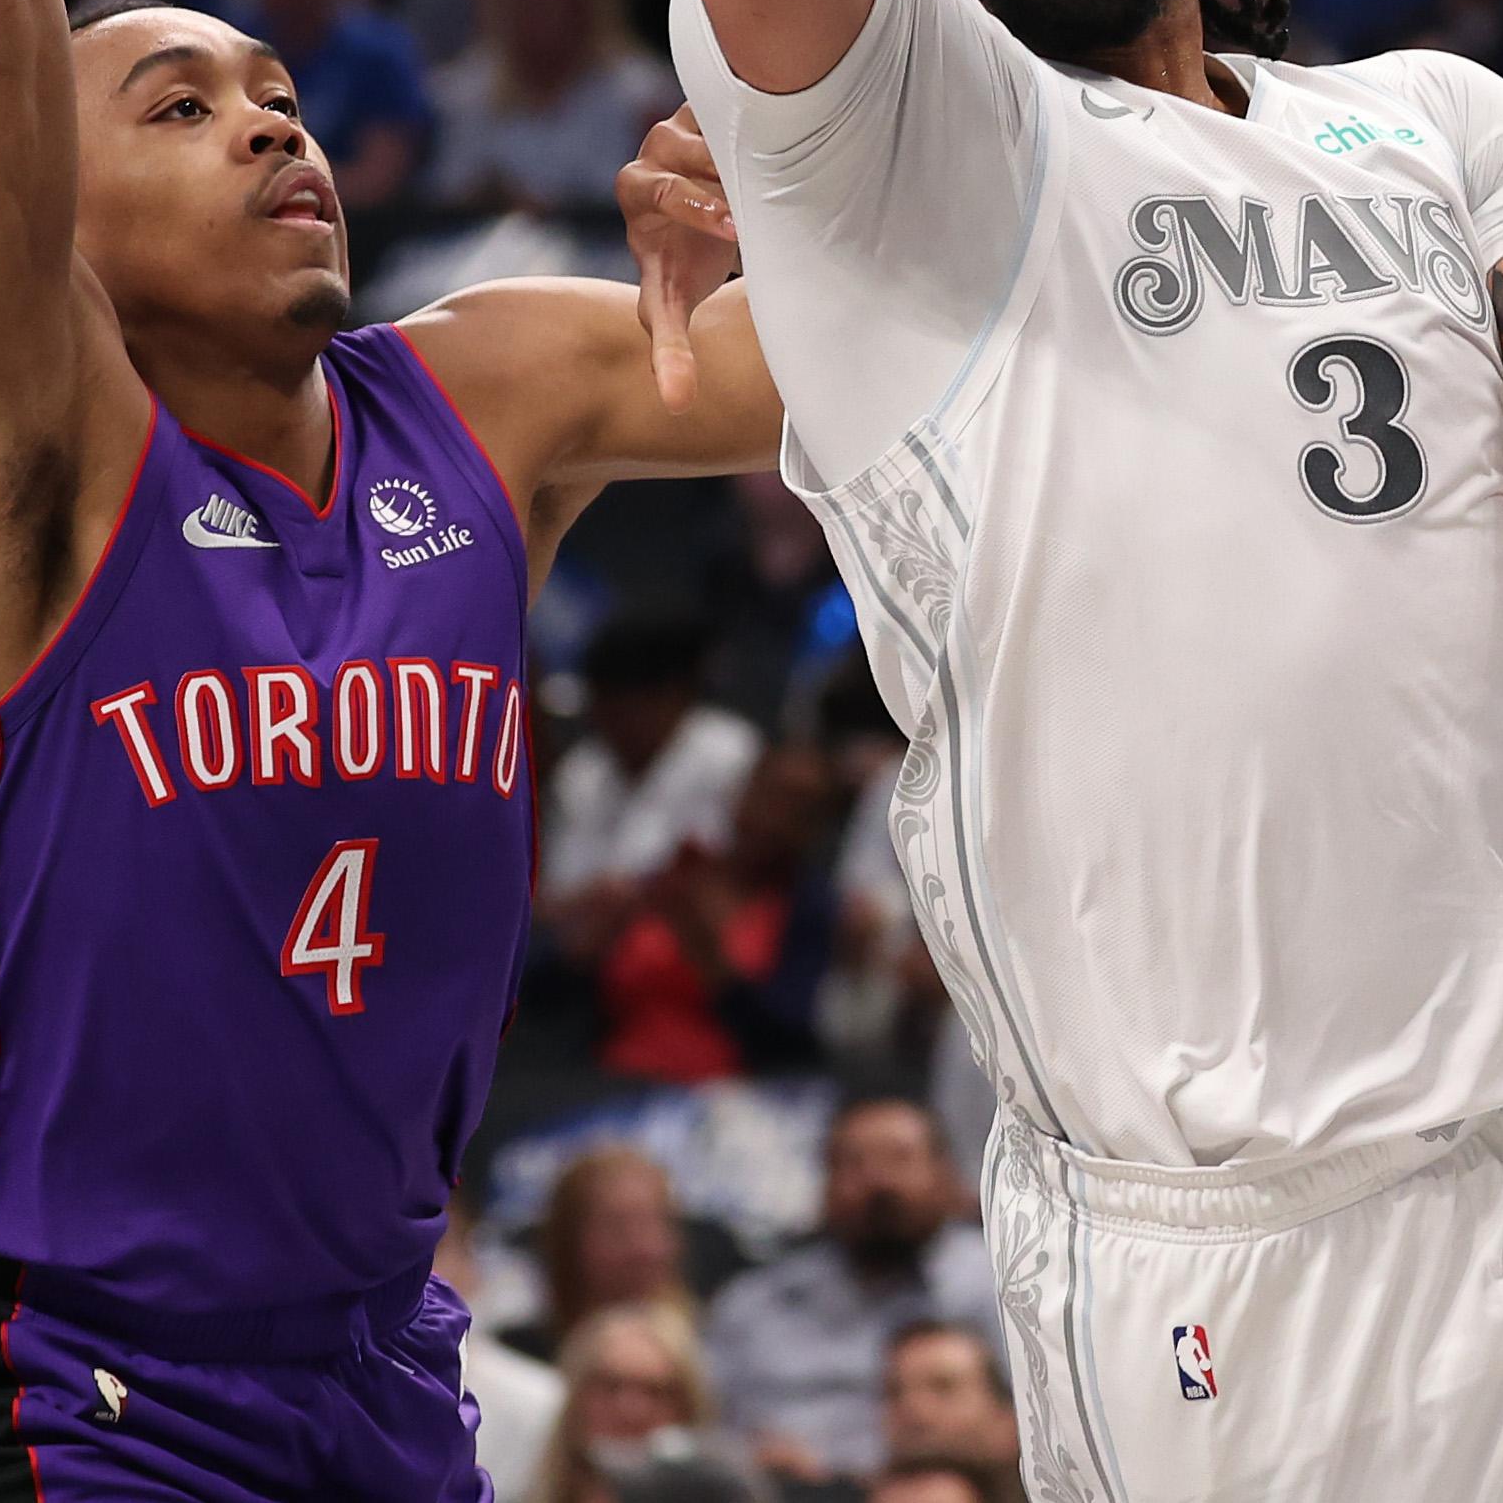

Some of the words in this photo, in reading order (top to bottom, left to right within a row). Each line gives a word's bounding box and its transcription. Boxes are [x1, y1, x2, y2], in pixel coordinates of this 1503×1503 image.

[1314, 115, 1424, 155] chie
[1113, 193, 1490, 336] MAVS
[1285, 333, 1429, 524] 3
[200, 493, 259, 538] NIKE
[381, 543, 428, 570] Sun
[424, 523, 474, 557] Life
[90, 656, 521, 808] TORONTO
[280, 837, 385, 1016] 4
